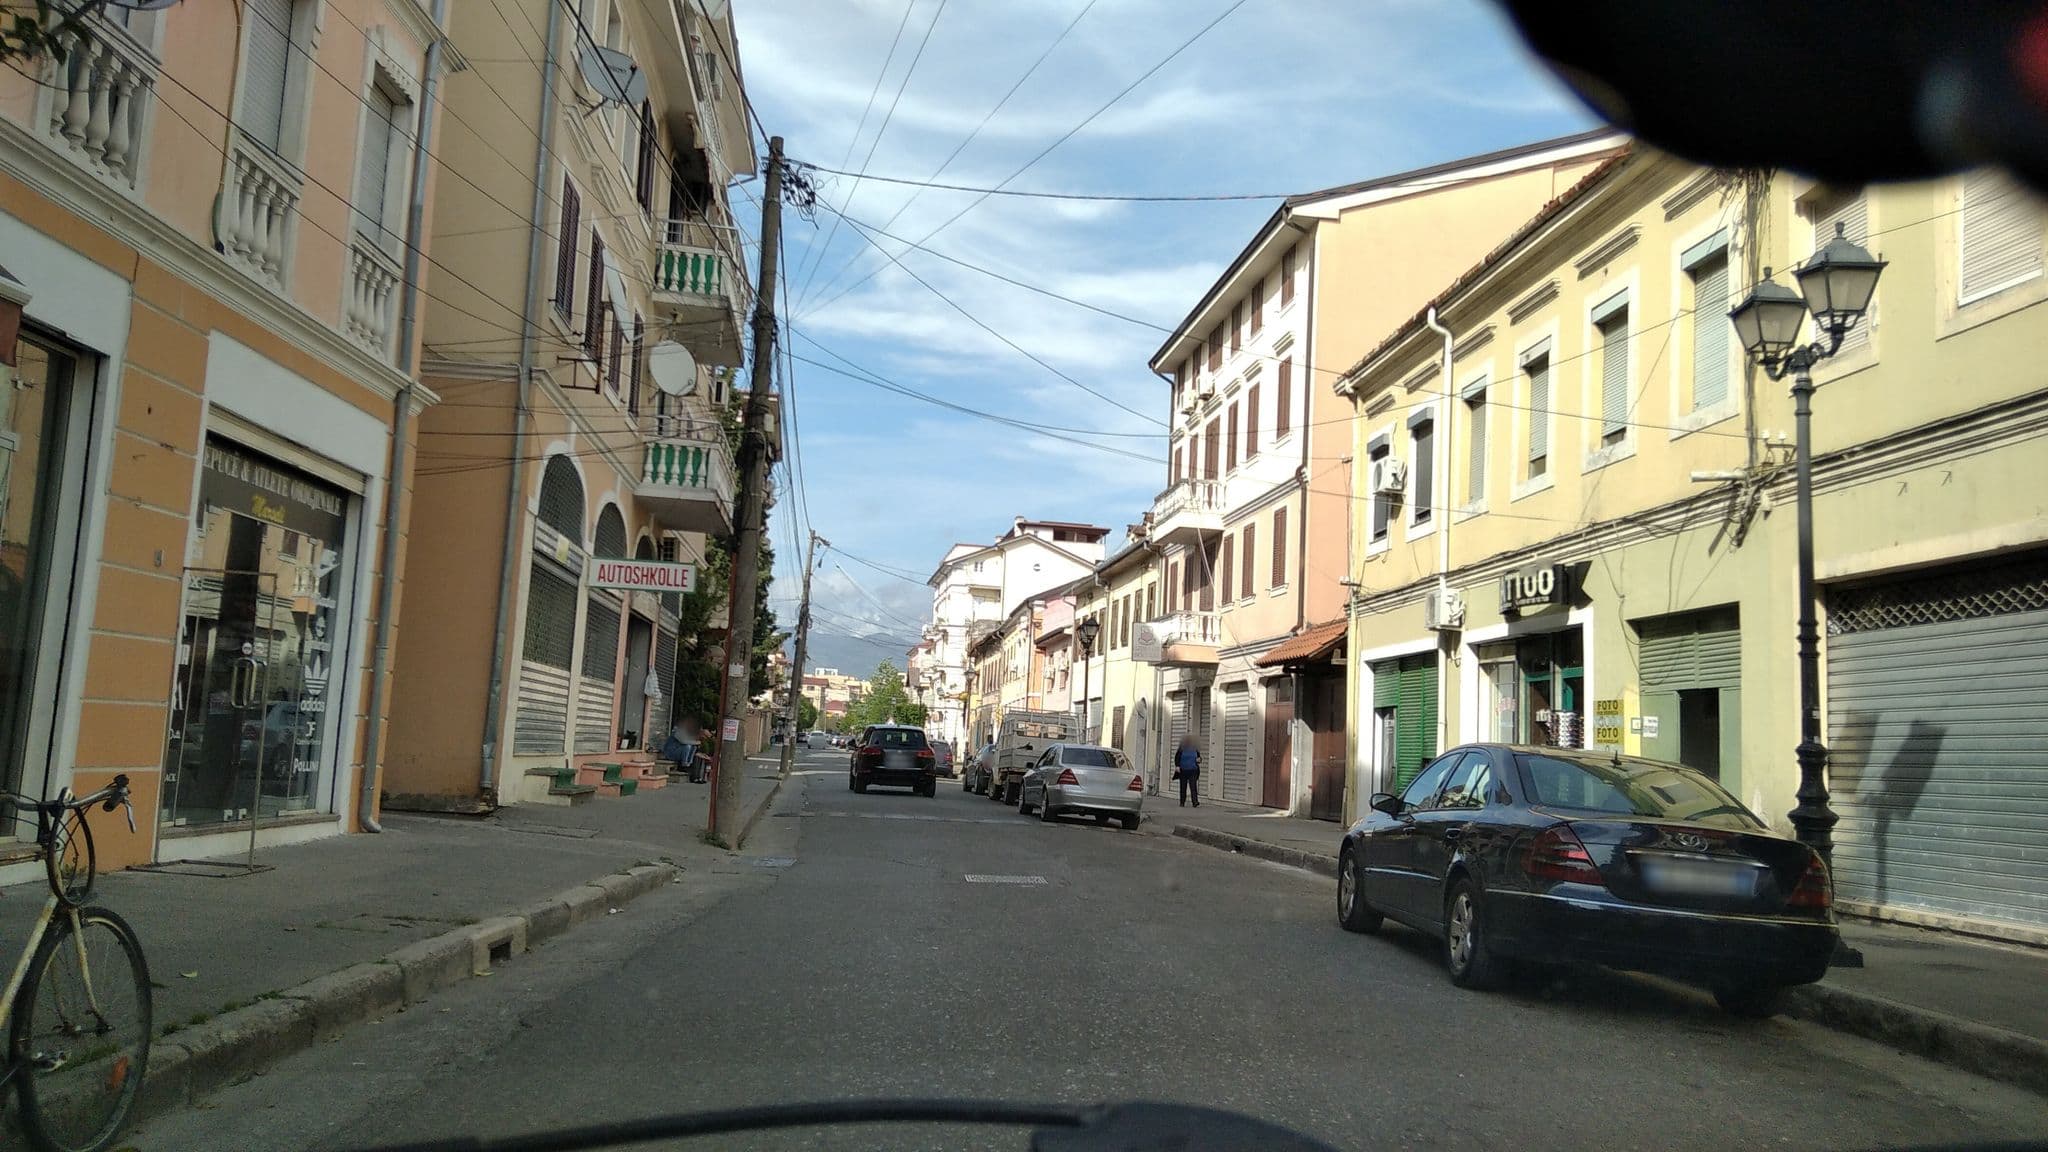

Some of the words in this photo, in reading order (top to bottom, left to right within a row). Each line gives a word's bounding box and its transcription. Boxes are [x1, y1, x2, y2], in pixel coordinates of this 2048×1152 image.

[598, 564, 689, 587] AUTOSHKOLLE
[1597, 700, 1618, 710] FOTO
[1597, 727, 1618, 738] FOTO
